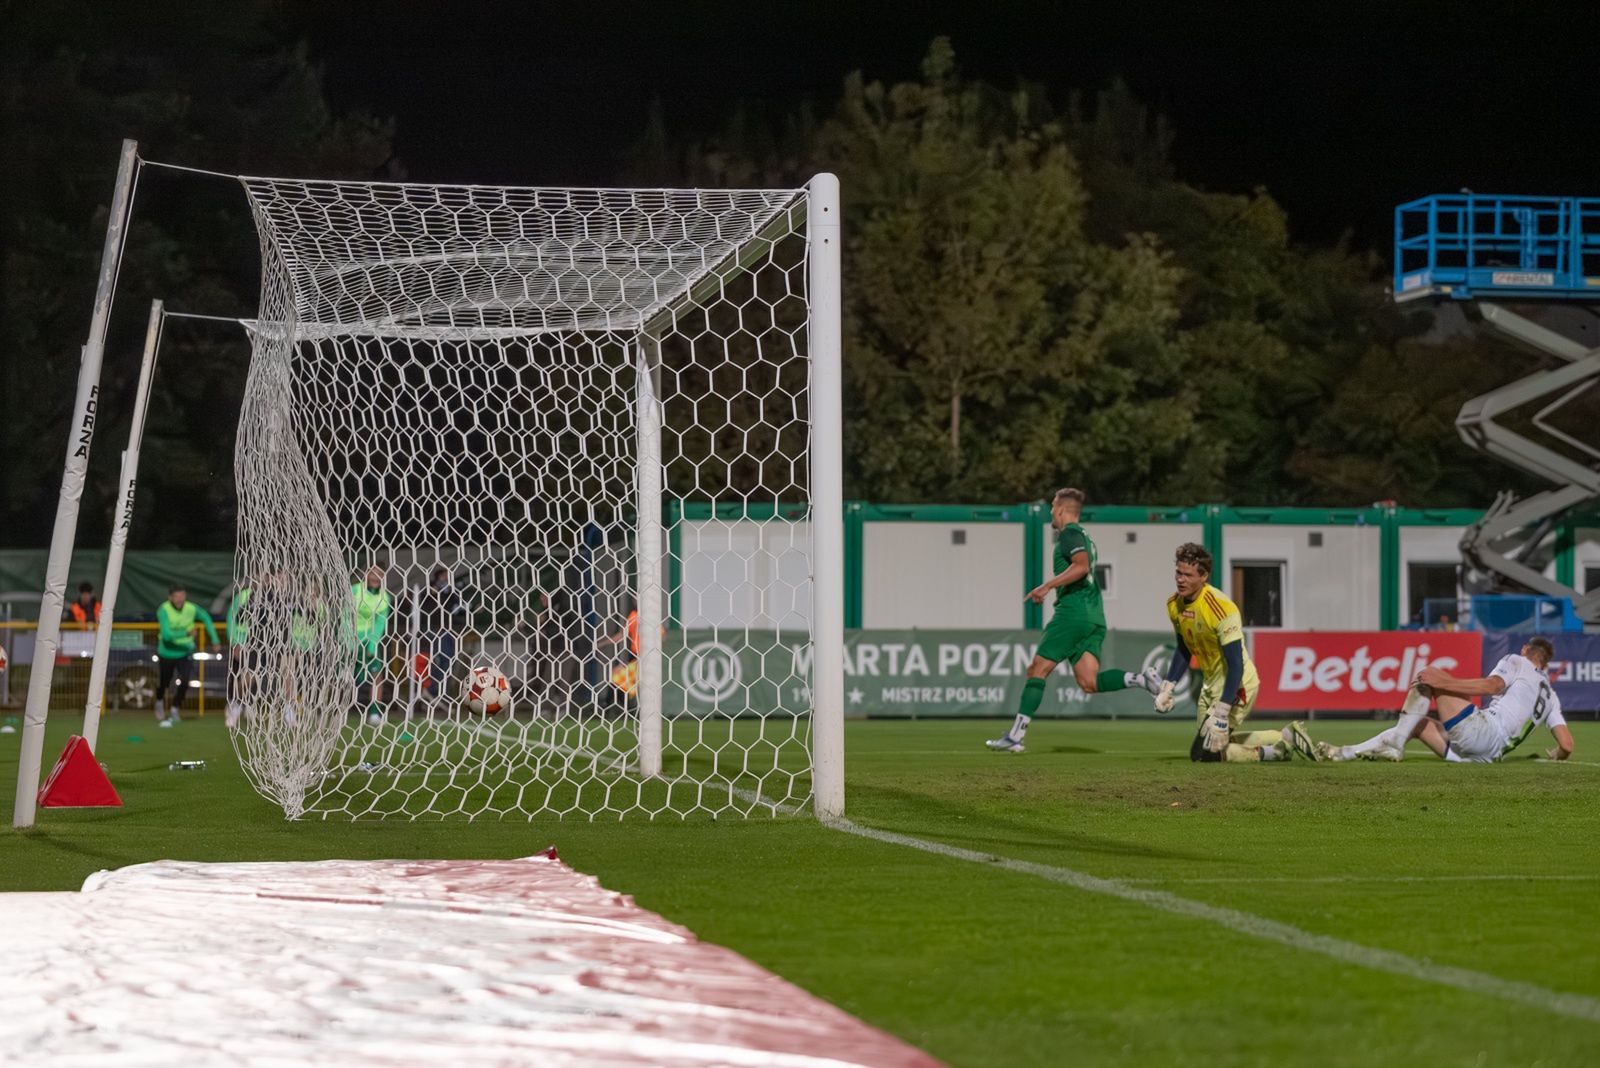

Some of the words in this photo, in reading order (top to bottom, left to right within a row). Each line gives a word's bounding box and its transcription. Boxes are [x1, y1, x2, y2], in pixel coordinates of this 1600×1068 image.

[74, 385, 99, 459] FORZA
[939, 643, 1075, 676] POZN
[882, 687, 942, 703] MISTRZ
[946, 687, 1005, 703] POLSKI
